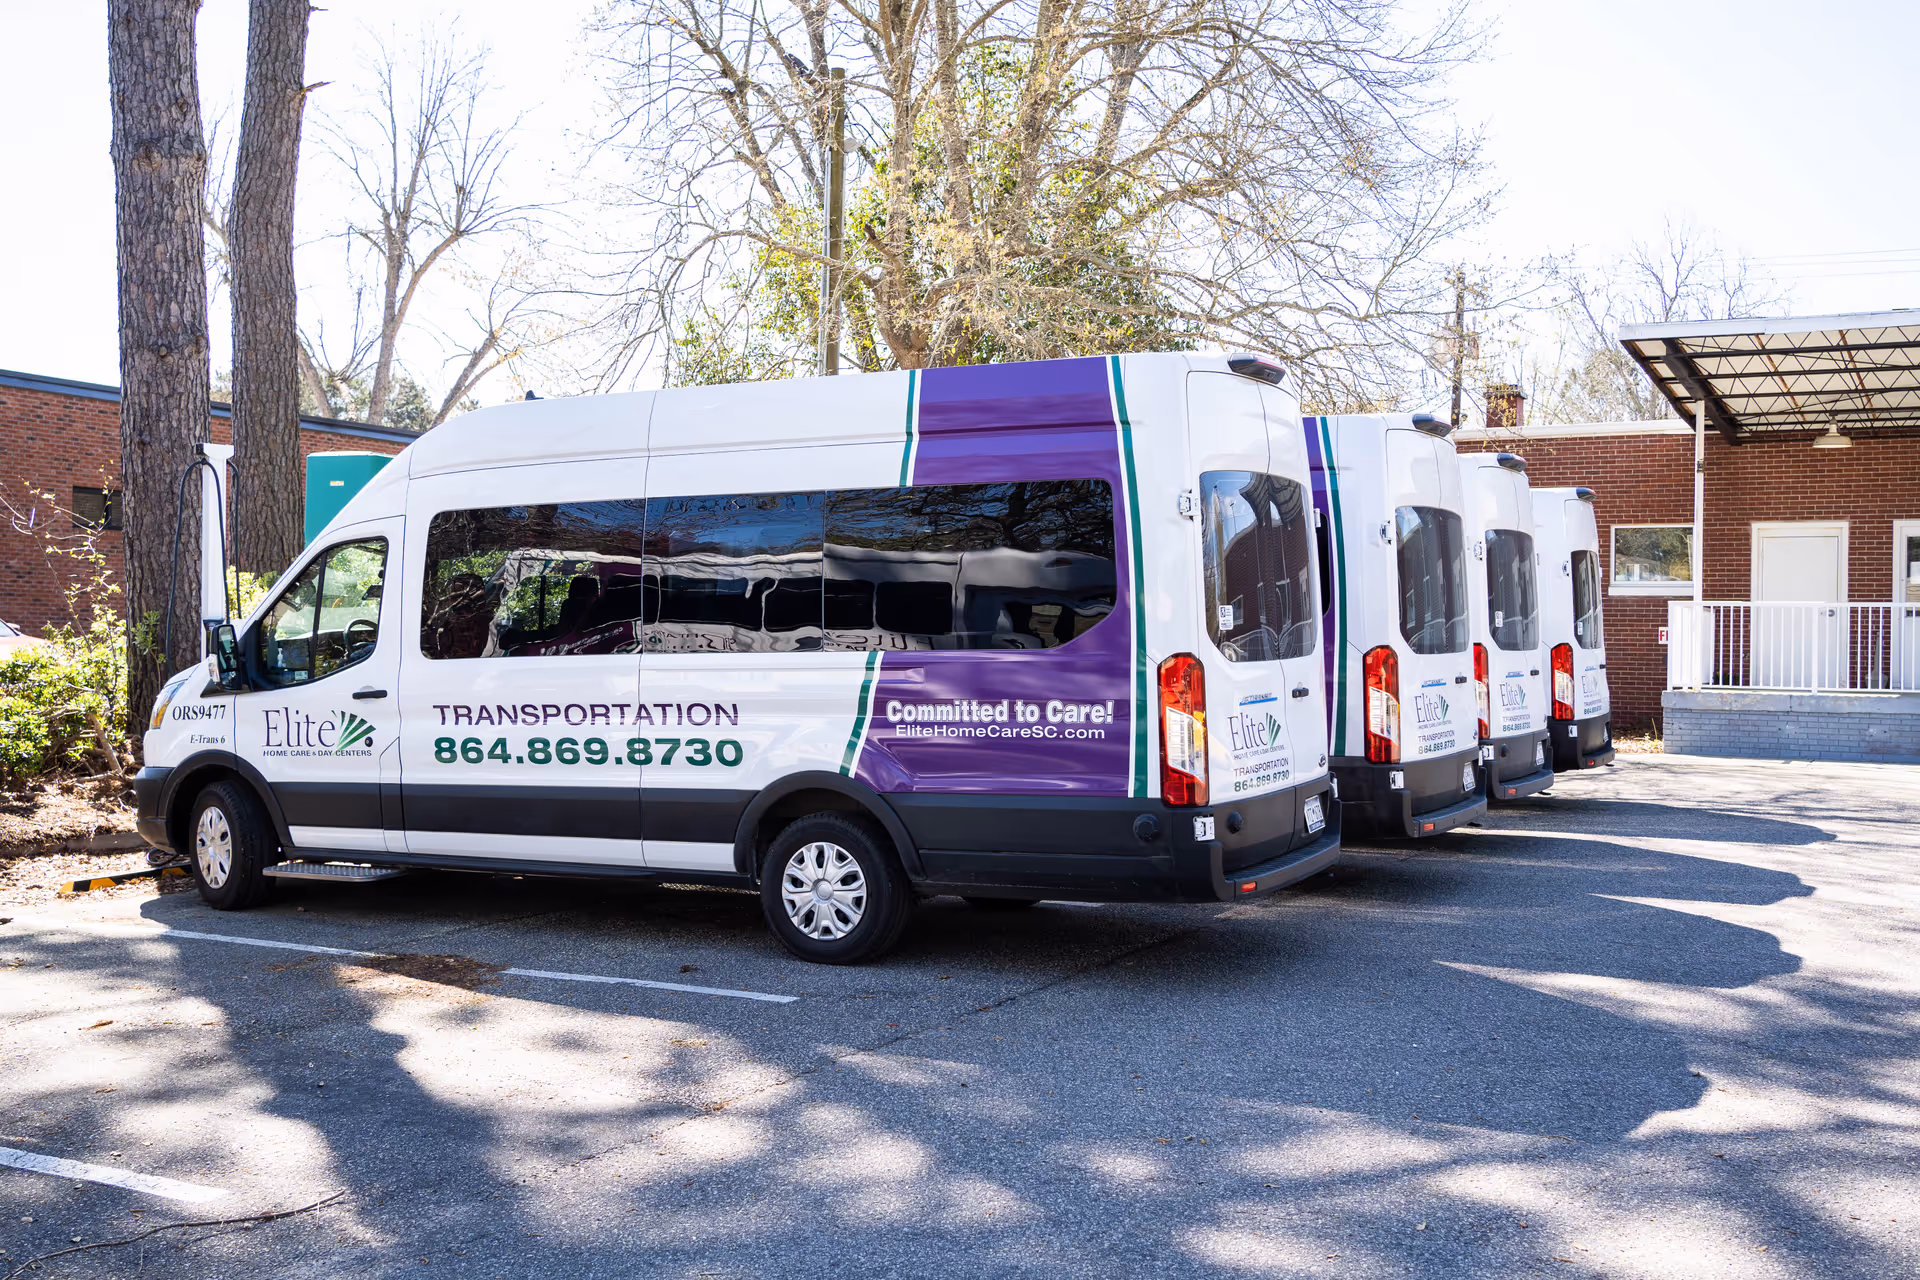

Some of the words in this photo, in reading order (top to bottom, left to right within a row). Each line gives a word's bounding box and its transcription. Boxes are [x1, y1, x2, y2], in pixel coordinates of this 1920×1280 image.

[172, 705, 226, 720] ORS9477
[432, 703, 739, 726] TRANSPORTATION
[886, 699, 1010, 723] Committed
[1014, 700, 1040, 723] to
[1046, 699, 1114, 724] Care!
[1414, 693, 1441, 723] Elite
[262, 707, 336, 748] Elite
[895, 724, 1105, 739] EliteHomeCareSC.com
[1227, 712, 1268, 751] Elite
[1417, 729, 1455, 743] TRANSPORTATION
[190, 735, 219, 744] E-Trans
[220, 735, 226, 744] 6
[1418, 739, 1456, 755] 864.869.8730
[434, 736, 744, 767] 864.869.8730
[1233, 757, 1289, 777] TRANSPORTATION
[1234, 769, 1290, 792] 864.869.8730
